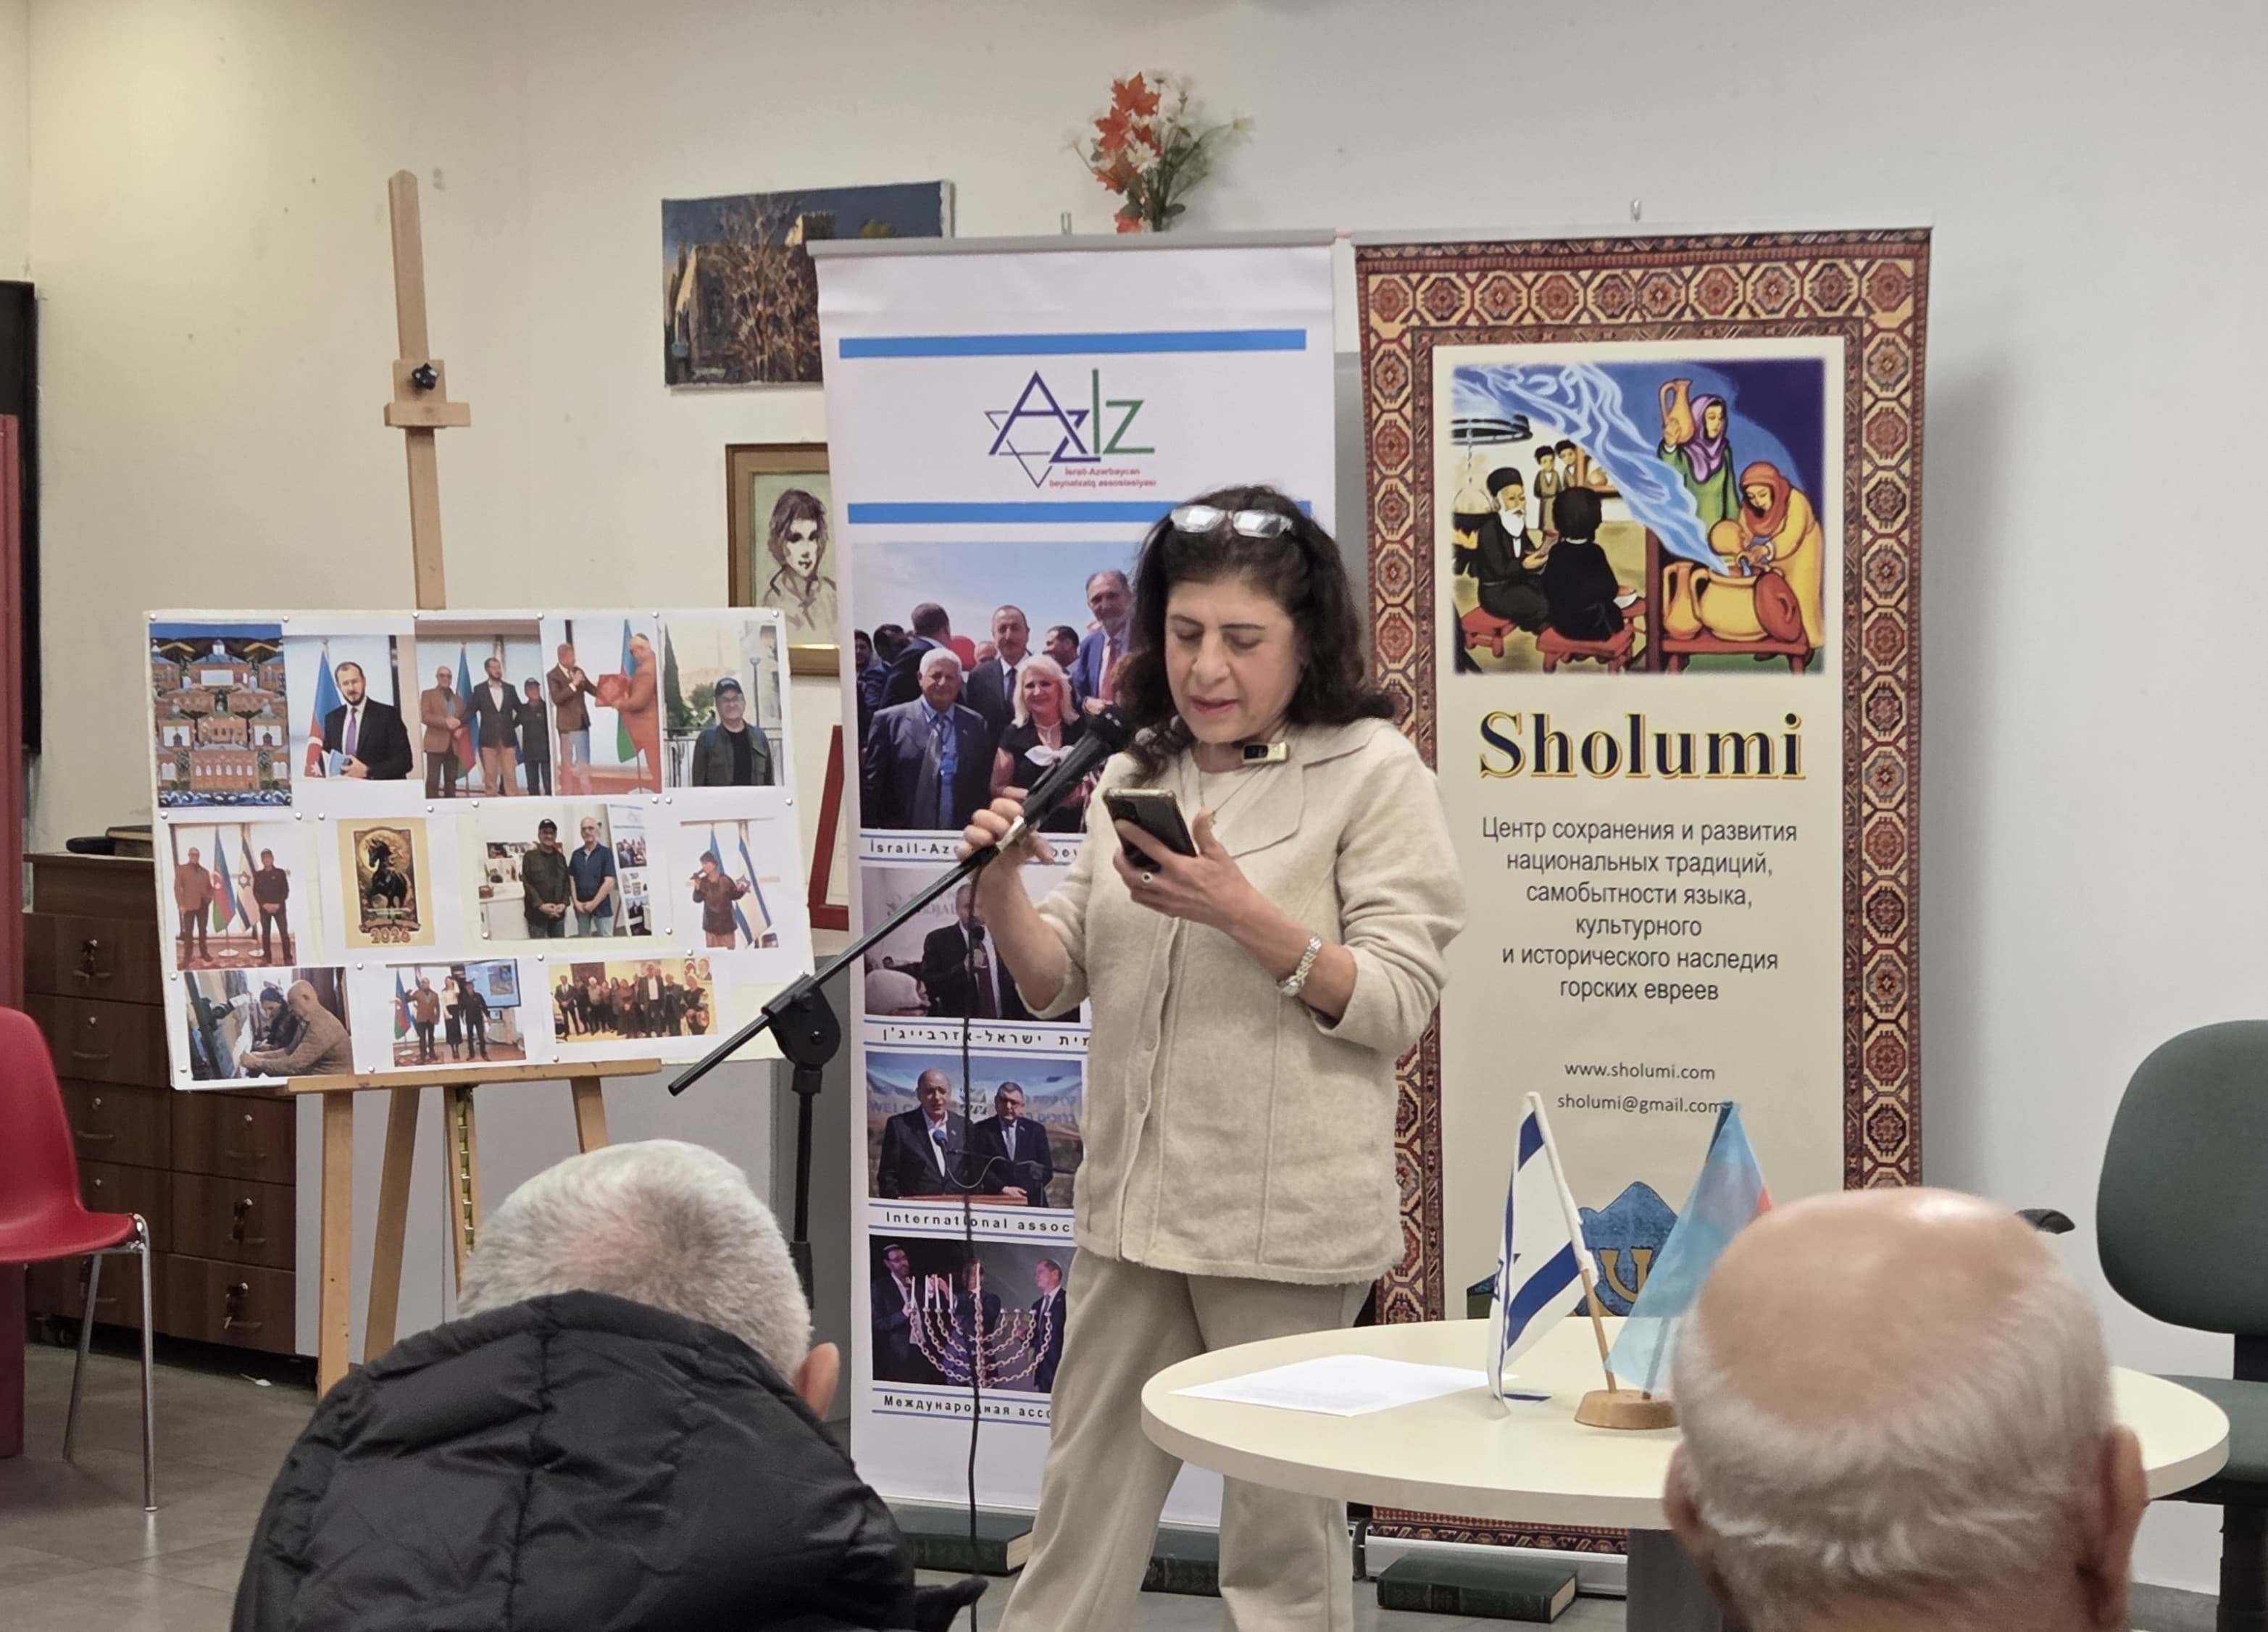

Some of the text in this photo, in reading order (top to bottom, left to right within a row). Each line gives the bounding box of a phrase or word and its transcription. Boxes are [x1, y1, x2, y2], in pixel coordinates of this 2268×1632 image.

[1480, 710, 1806, 780] Sholumi
[1482, 816, 1798, 846] Центр сохранения и развития
[1506, 852, 1773, 879] национальных традиций,
[1526, 880, 1753, 909] самобытности языка,
[370, 927, 411, 944] 2026
[1576, 917, 1703, 941] культурного
[1502, 947, 1779, 974] и исторического наследия
[1560, 980, 1719, 1004] горских евреев
[1564, 1062, 1716, 1081] www.sholumi.com
[1557, 1093, 1722, 1115] sholumi@gmail.com
